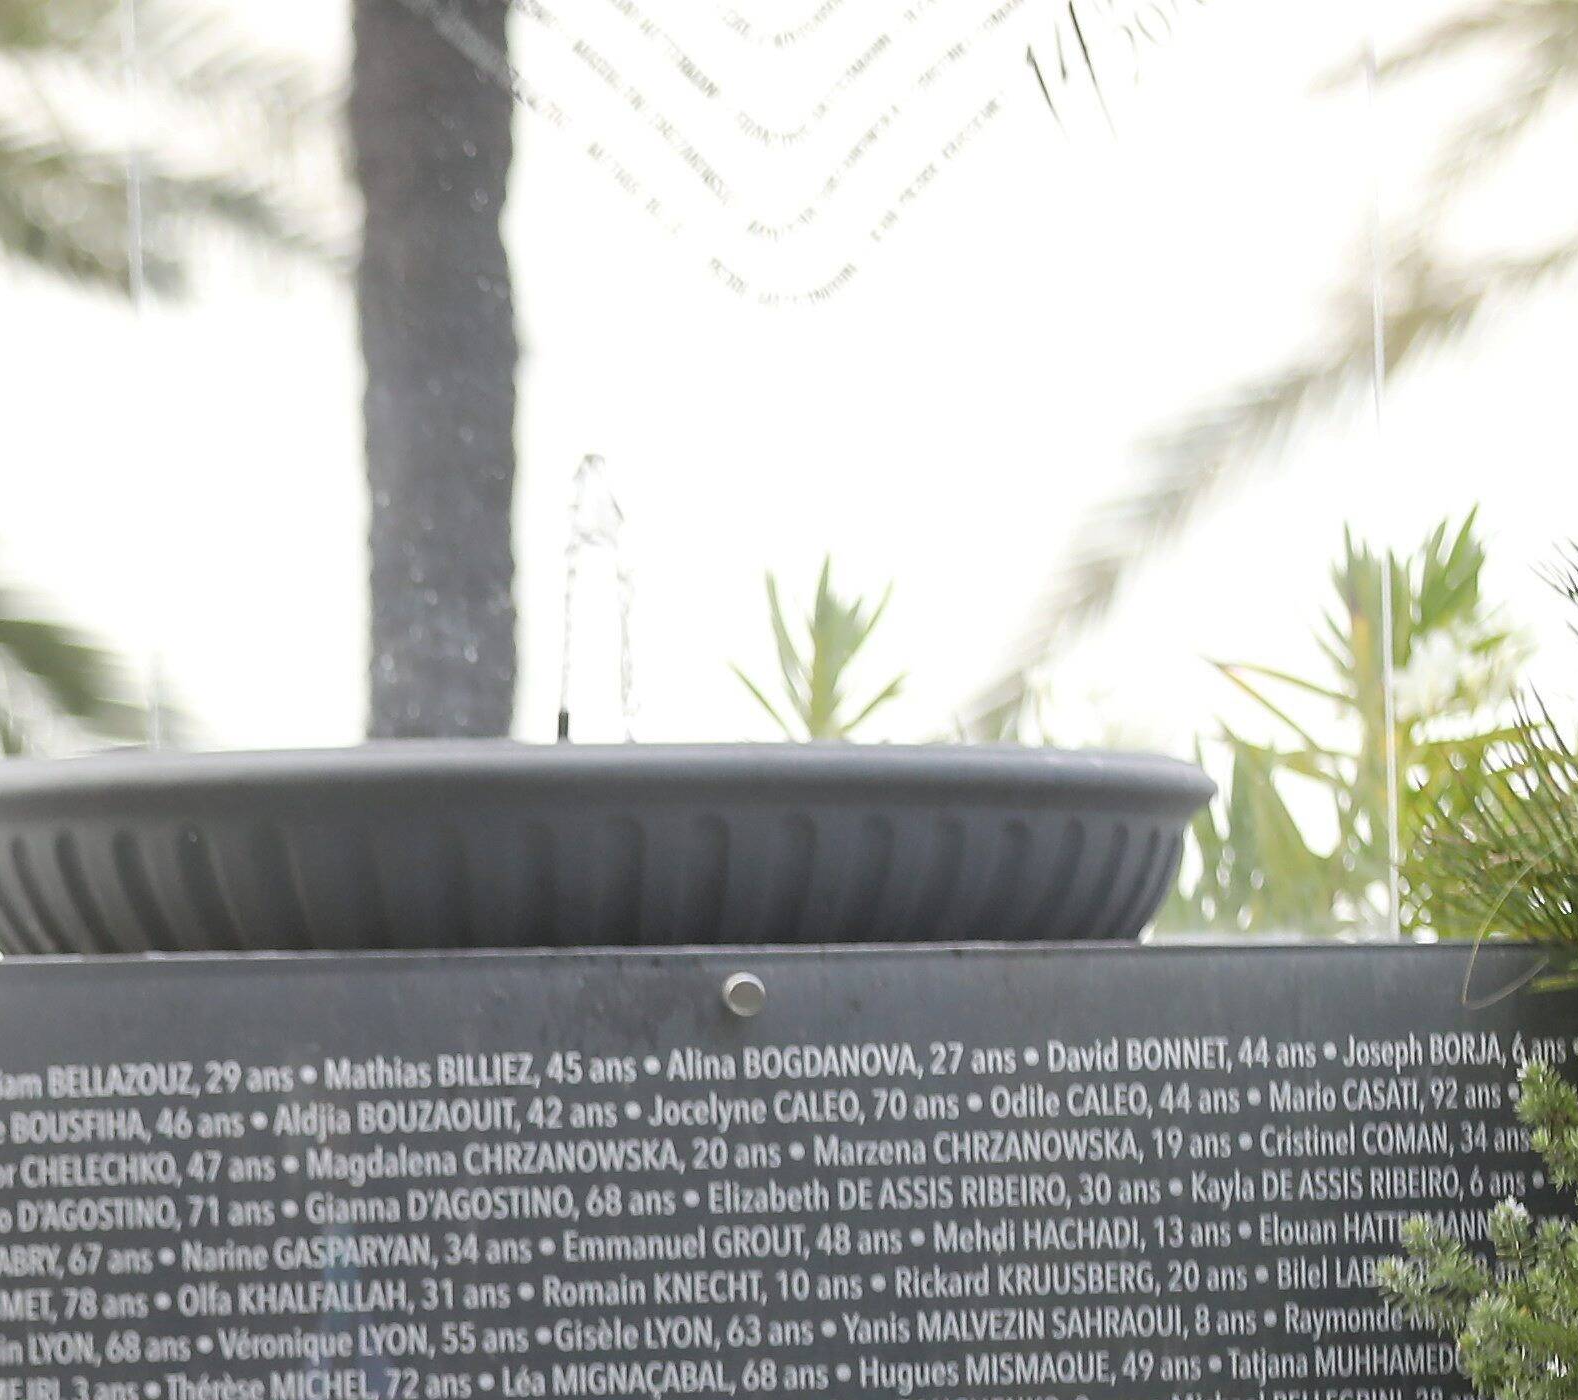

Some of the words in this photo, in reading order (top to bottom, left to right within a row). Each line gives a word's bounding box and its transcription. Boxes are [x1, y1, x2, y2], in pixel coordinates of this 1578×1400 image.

[204, 1060, 242, 1095] 29
[245, 1066, 294, 1093] ans
[323, 1054, 432, 1091] Mathias
[436, 1052, 541, 1089] BILLIEZ,
[545, 1051, 583, 1085] 45
[588, 1056, 637, 1084] ans
[666, 1047, 736, 1082] Alina
[742, 1042, 923, 1081] BOGDANOVA,
[929, 1042, 964, 1076] 27
[970, 1048, 1016, 1076] ans
[1046, 1038, 1119, 1074] David
[1125, 1037, 1232, 1073] BONNET,
[1237, 1036, 1269, 1070] 44
[196, 1112, 245, 1139] ans
[272, 1101, 351, 1143] Aldjia
[356, 1097, 521, 1135] BOUZAOUIT,
[526, 1096, 563, 1130] 42
[569, 1102, 618, 1129] ans
[647, 1090, 767, 1133] Jocelyne
[772, 1089, 865, 1125] CALEO,
[873, 1088, 908, 1122] 70
[912, 1094, 959, 1121] ans
[989, 1084, 1060, 1119] Odile
[1066, 1082, 1153, 1119] CALEO,
[1158, 1082, 1192, 1116] 44
[1197, 1088, 1240, 1115] ans
[186, 1150, 222, 1184] 47
[227, 1156, 276, 1183] ans
[305, 1143, 457, 1187] Magdalena
[462, 1137, 685, 1176] CHRZANOWSKA,
[691, 1137, 728, 1171] 20
[733, 1143, 781, 1170] ans
[812, 1132, 926, 1168] Marzena
[932, 1128, 1144, 1165] CHRZANOWSKA,
[1151, 1127, 1183, 1160] 19
[1188, 1134, 1231, 1160] ans
[188, 1194, 220, 1228] 71
[227, 1200, 275, 1227] ans
[304, 1190, 401, 1225] Gianna
[406, 1185, 580, 1222] D'AGOSTINO,
[584, 1184, 622, 1218] 68
[627, 1191, 676, 1217] ans
[707, 1178, 830, 1215] Elizabeth
[836, 1178, 873, 1212] DE
[878, 1176, 954, 1211] ASSIS
[960, 1174, 1072, 1209] RIBEIRO,
[1078, 1173, 1112, 1206] 30
[1117, 1180, 1161, 1205] ans
[1190, 1169, 1255, 1210] Kayla
[181, 1239, 269, 1273] Narine
[272, 1232, 438, 1270] GASPARYAN,
[444, 1232, 479, 1266] 34
[484, 1238, 532, 1265] ans
[562, 1226, 706, 1263] Emmanuel
[711, 1224, 810, 1260] GROUT,
[814, 1223, 852, 1257] 48
[856, 1229, 903, 1256] ans
[932, 1218, 1015, 1254] Mehdi
[1022, 1216, 1146, 1252] HACHADI,
[1153, 1217, 1184, 1249] 13
[1189, 1223, 1231, 1248] ans
[176, 1282, 232, 1317] Olfa
[237, 1278, 415, 1316] KHALFALLAH,
[421, 1278, 454, 1311] 31
[462, 1284, 511, 1310] ans
[542, 1274, 646, 1308] Romain
[653, 1270, 767, 1305] KNECHT,
[775, 1269, 810, 1302] 10
[815, 1275, 863, 1301] ans
[894, 1263, 990, 1299] Rickard
[996, 1260, 1161, 1297] KRUUSBERG,
[1167, 1261, 1200, 1293] 20
[1205, 1267, 1248, 1292] ans
[357, 1322, 436, 1358] LYON,
[441, 1321, 477, 1355] 55
[481, 1328, 529, 1354] ans
[553, 1316, 639, 1352] Gisèle
[643, 1315, 721, 1351] LYON,
[725, 1315, 762, 1348] 63
[767, 1321, 814, 1347] ans
[841, 1311, 910, 1345] Yanis
[916, 1308, 1045, 1343] MALVEZIN
[1051, 1305, 1189, 1340] SAHRAOUI,
[1194, 1305, 1210, 1336] 8
[1215, 1310, 1257, 1336] ans
[385, 1367, 419, 1400] 72
[424, 1374, 472, 1400] ans
[501, 1365, 546, 1398] Léa
[741, 1359, 777, 1392] 68
[782, 1365, 829, 1391] ans
[858, 1355, 959, 1396] Hugues
[964, 1350, 1116, 1386] MISMAQUE,
[1121, 1350, 1154, 1382] 49
[1159, 1356, 1201, 1381] ans
